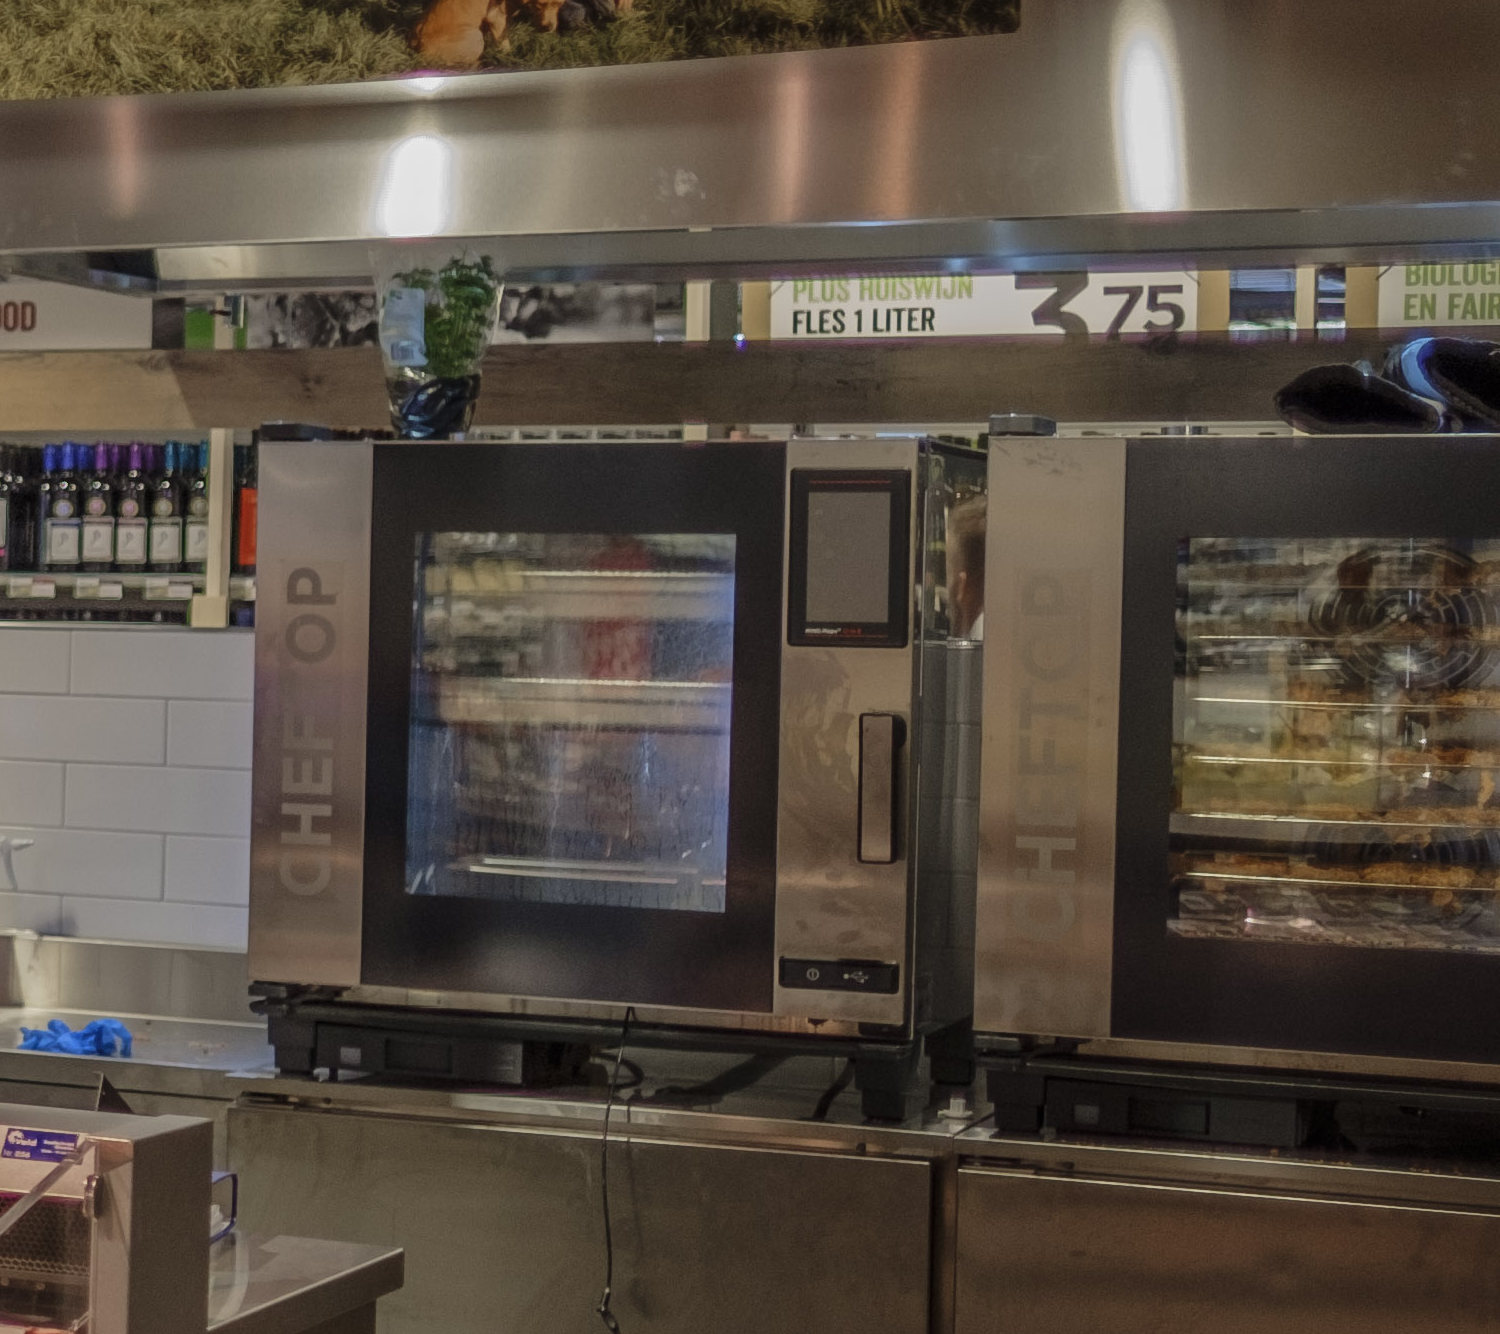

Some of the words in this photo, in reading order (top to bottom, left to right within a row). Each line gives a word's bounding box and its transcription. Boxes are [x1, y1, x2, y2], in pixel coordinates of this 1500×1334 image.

[1405, 264, 1500, 287] BIOLOG
[792, 277, 851, 303] PLUS
[792, 309, 846, 334] FLES
[855, 309, 863, 333] 1
[872, 307, 936, 333] LITER
[1403, 293, 1437, 321] EN
[278, 566, 337, 898] CHEFOP
